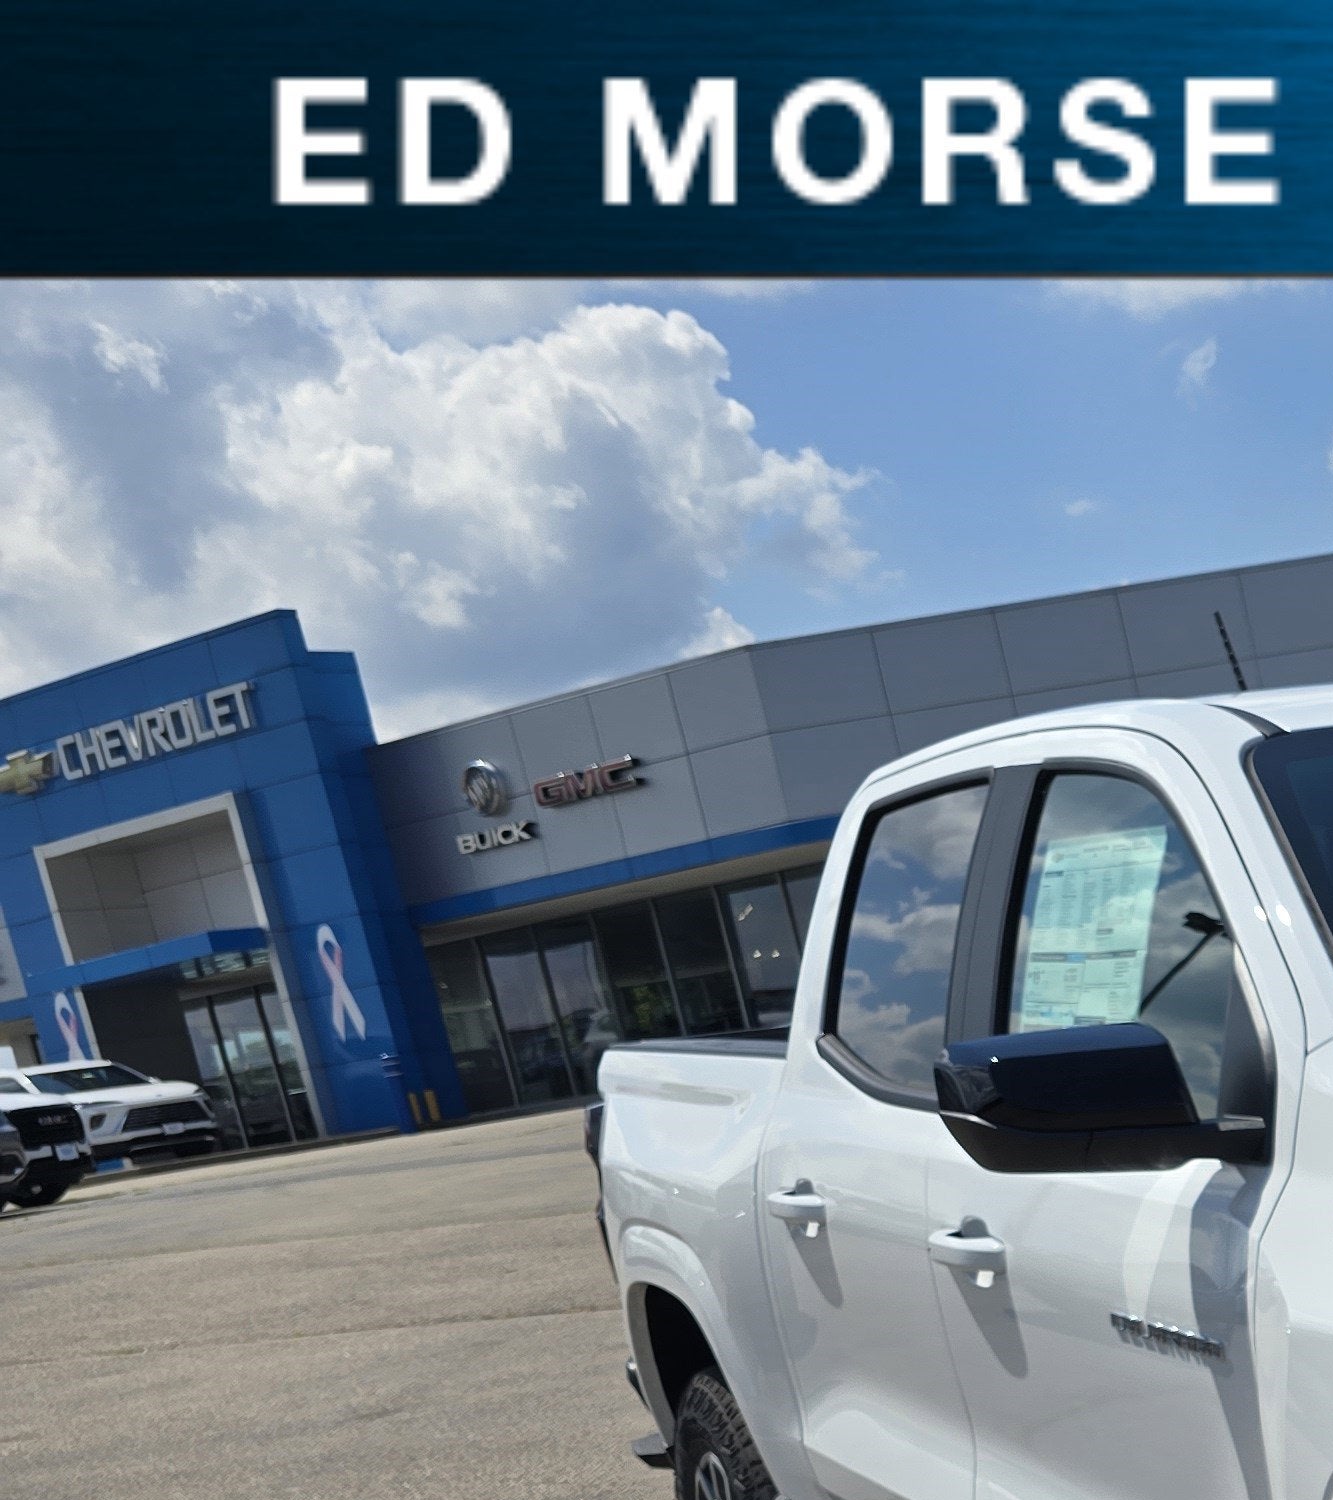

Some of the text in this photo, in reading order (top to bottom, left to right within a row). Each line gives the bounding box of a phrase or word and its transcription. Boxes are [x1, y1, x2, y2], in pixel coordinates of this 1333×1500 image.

[56, 681, 251, 781] CHEVROLET
[533, 754, 637, 809] GMC
[456, 820, 532, 854] BUICK
